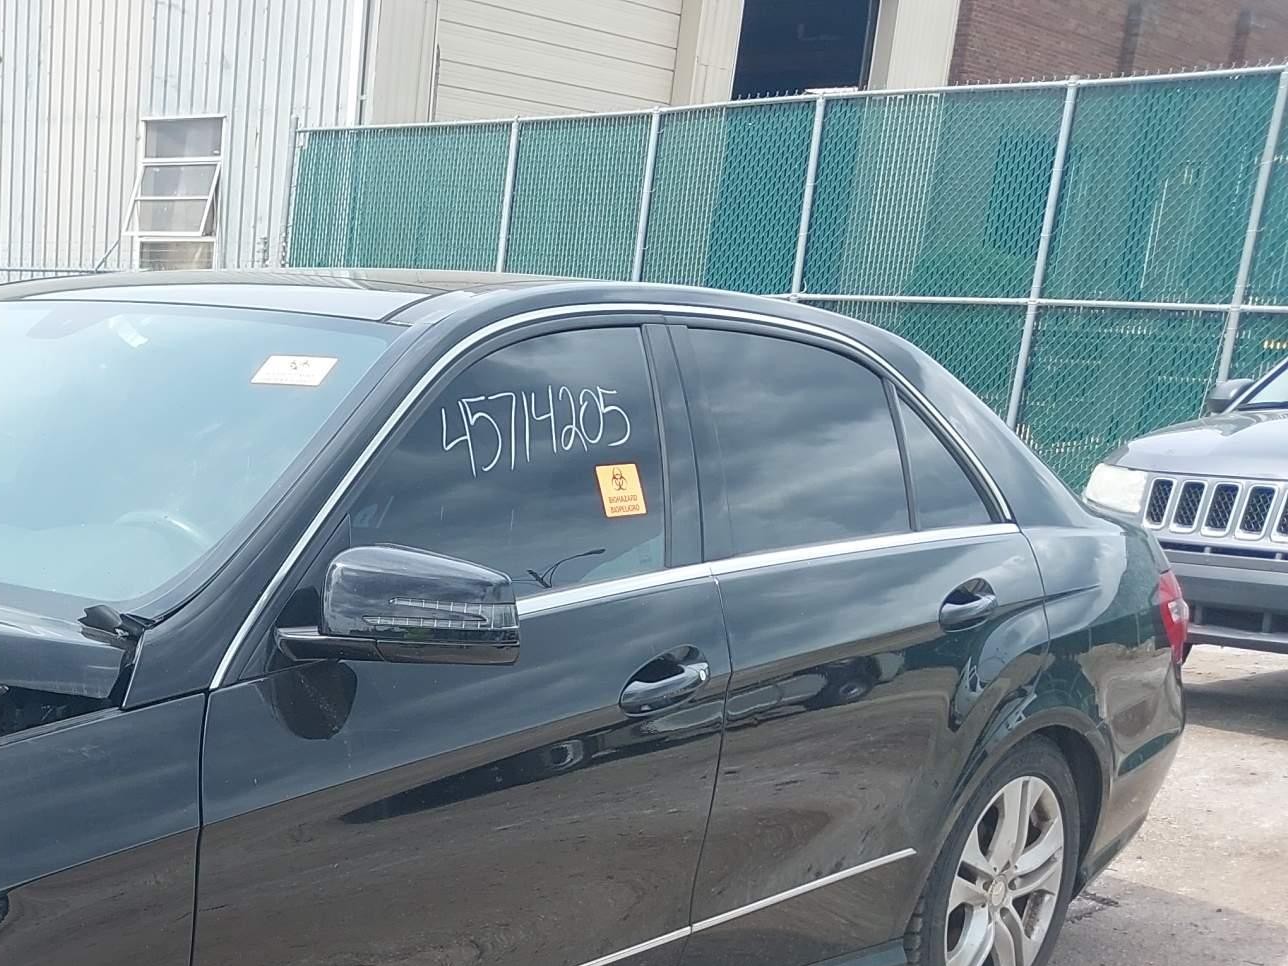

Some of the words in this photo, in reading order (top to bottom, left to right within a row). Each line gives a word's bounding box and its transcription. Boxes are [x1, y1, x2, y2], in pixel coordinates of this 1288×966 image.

[441, 384, 631, 478] 45714205
[608, 494, 638, 504] BIOHAZARD
[610, 503, 640, 513] BIOPELIGRO
